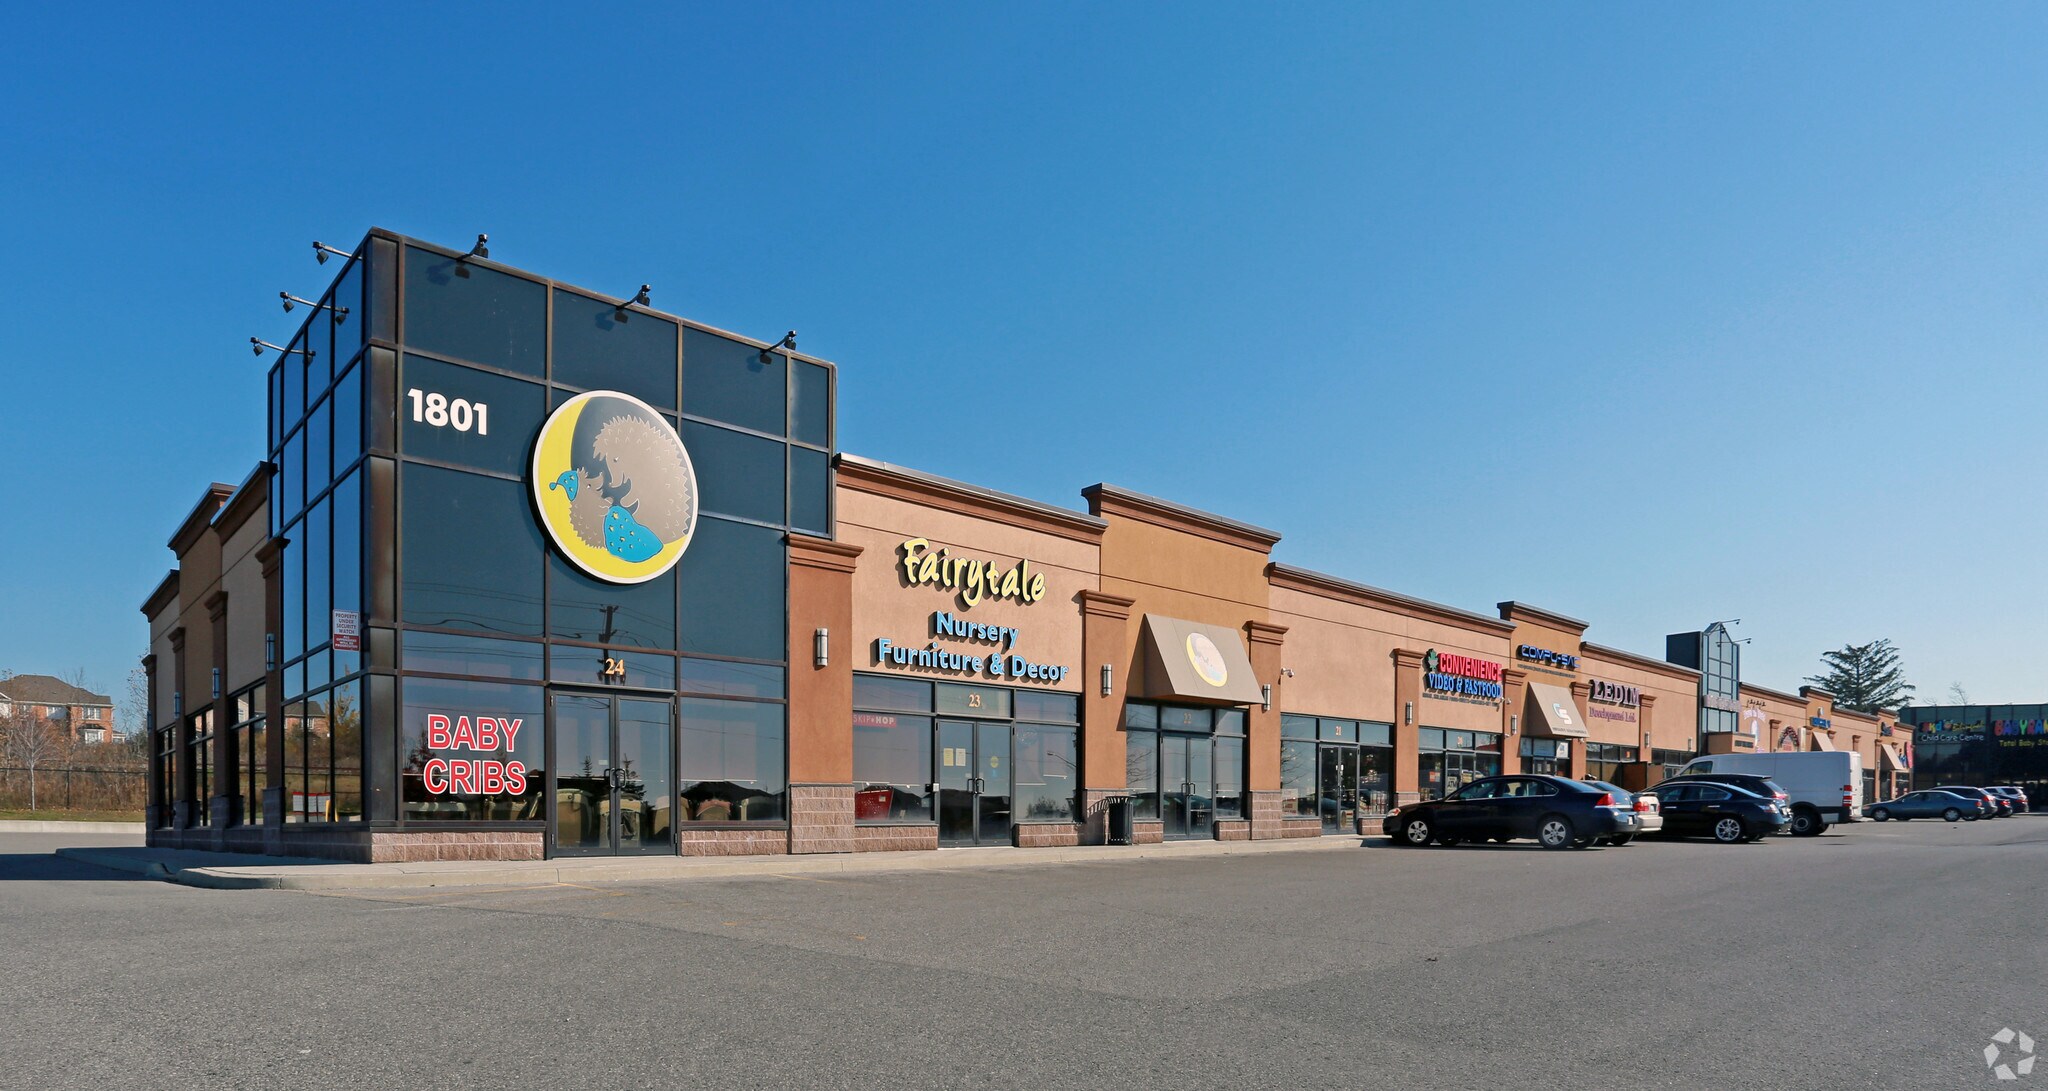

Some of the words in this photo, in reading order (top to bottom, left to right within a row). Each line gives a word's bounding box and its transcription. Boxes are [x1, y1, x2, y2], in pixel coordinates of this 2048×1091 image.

[408, 388, 487, 436] 1801
[903, 538, 1046, 607] Fairytale
[936, 611, 1019, 649] Nursery
[605, 658, 625, 676] 24
[878, 638, 984, 672] Furniture
[990, 652, 1005, 675] &
[1012, 655, 1069, 681] Decor
[1440, 653, 1503, 681] CONVENIENCE
[1429, 673, 1454, 691] VIDEO
[1456, 678, 1462, 692] &
[1464, 679, 1503, 698] FASTFOOD
[1593, 680, 1640, 707] LEDIM
[968, 694, 981, 708] 23
[428, 713, 523, 752] BABY
[853, 714, 871, 723] SKIP
[875, 716, 895, 725] HOP
[1921, 733, 1939, 742] Child
[2018, 740, 2035, 748] Baby
[423, 758, 527, 795] CRIBS
